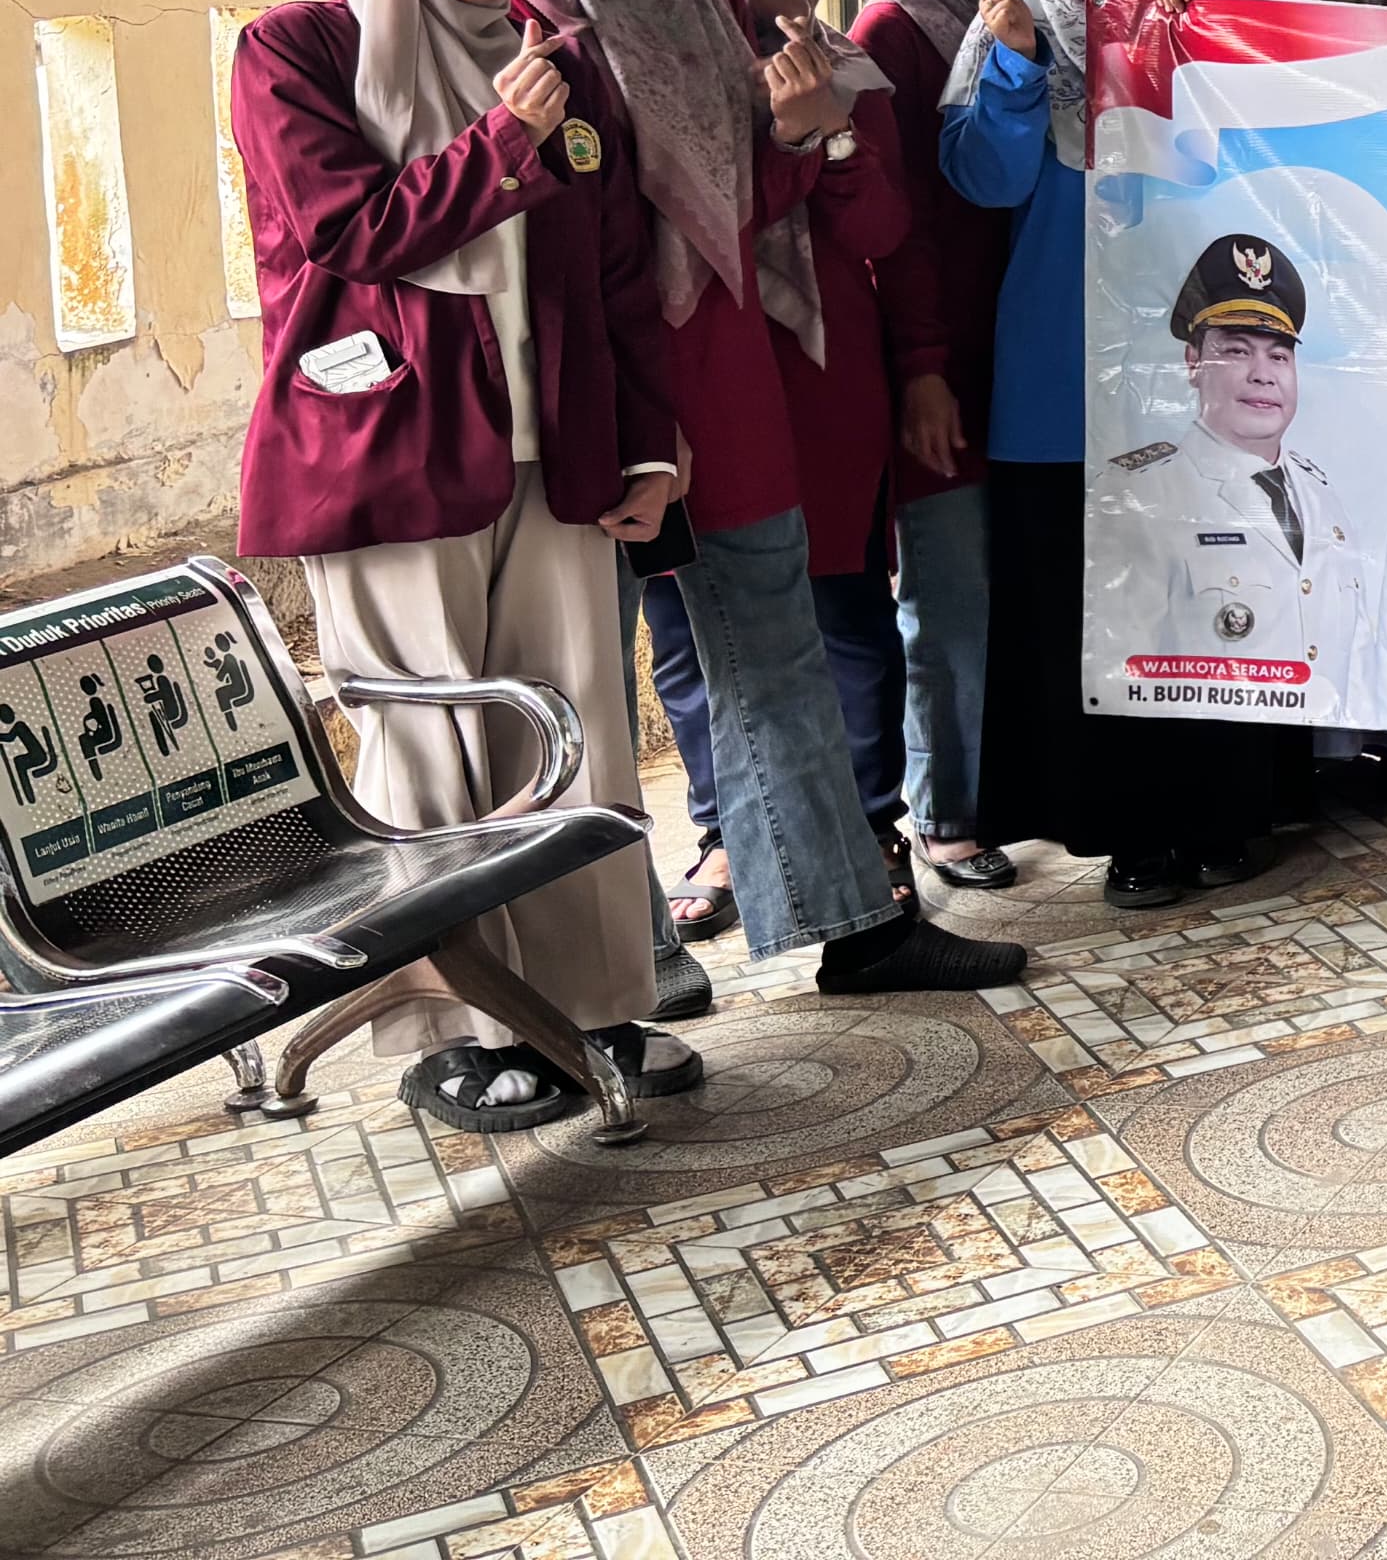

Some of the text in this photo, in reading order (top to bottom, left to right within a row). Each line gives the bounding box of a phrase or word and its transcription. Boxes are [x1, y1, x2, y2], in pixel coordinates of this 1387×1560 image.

[3, 587, 207, 653] Duduk Prioritas Priority Seats
[1142, 660, 1295, 679] WALIKOTA SERANG
[1128, 684, 1306, 709] H. BUDI RUSTANDI
